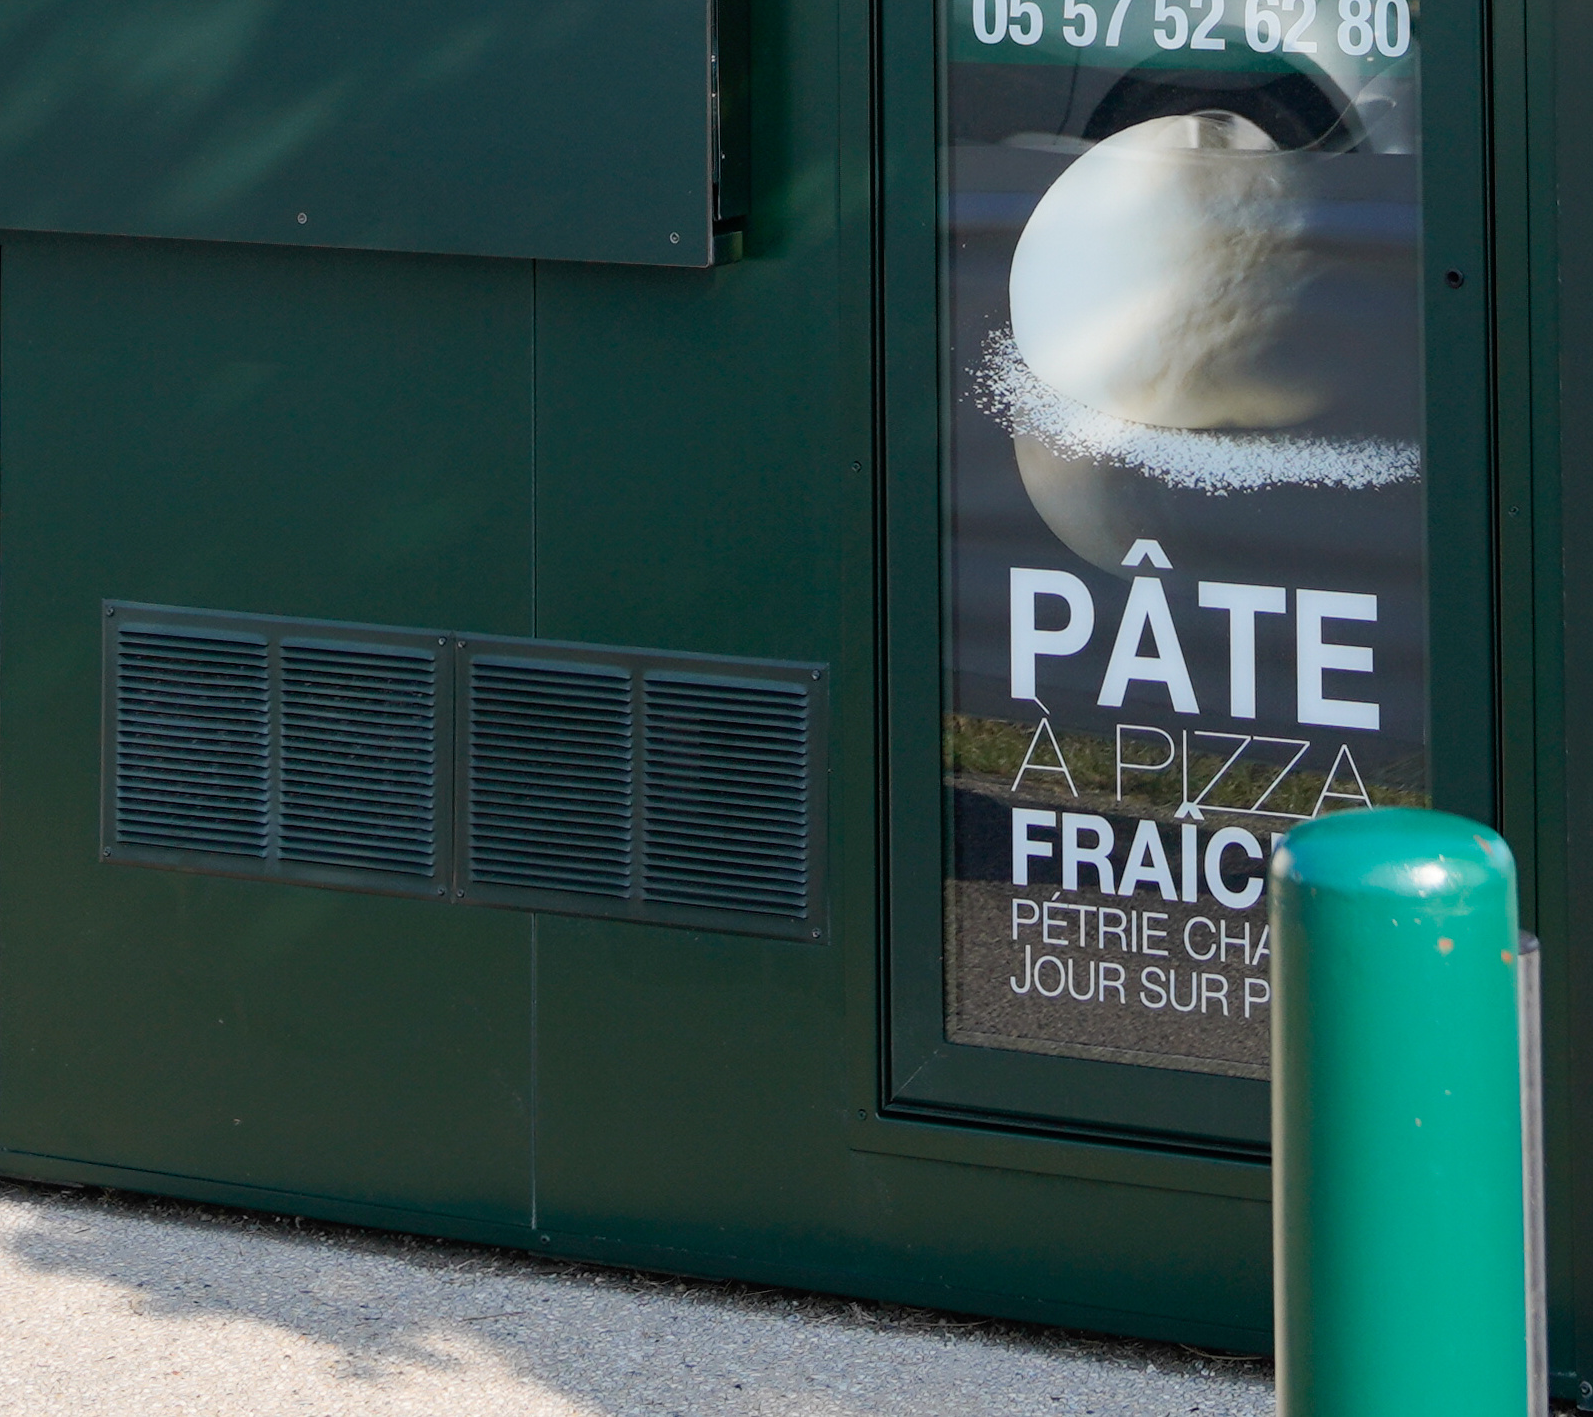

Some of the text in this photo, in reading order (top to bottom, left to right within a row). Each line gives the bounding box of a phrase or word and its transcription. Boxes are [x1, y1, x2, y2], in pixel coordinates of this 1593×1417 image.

[1010, 538, 1381, 731] PÂTE
[1011, 696, 1374, 819] À PIZZA
[1012, 801, 1282, 910] FRAÎC
[1012, 891, 1169, 957] PÉTRIE
[1010, 943, 1126, 1005] JOUR
[1139, 965, 1229, 1017] SUR
